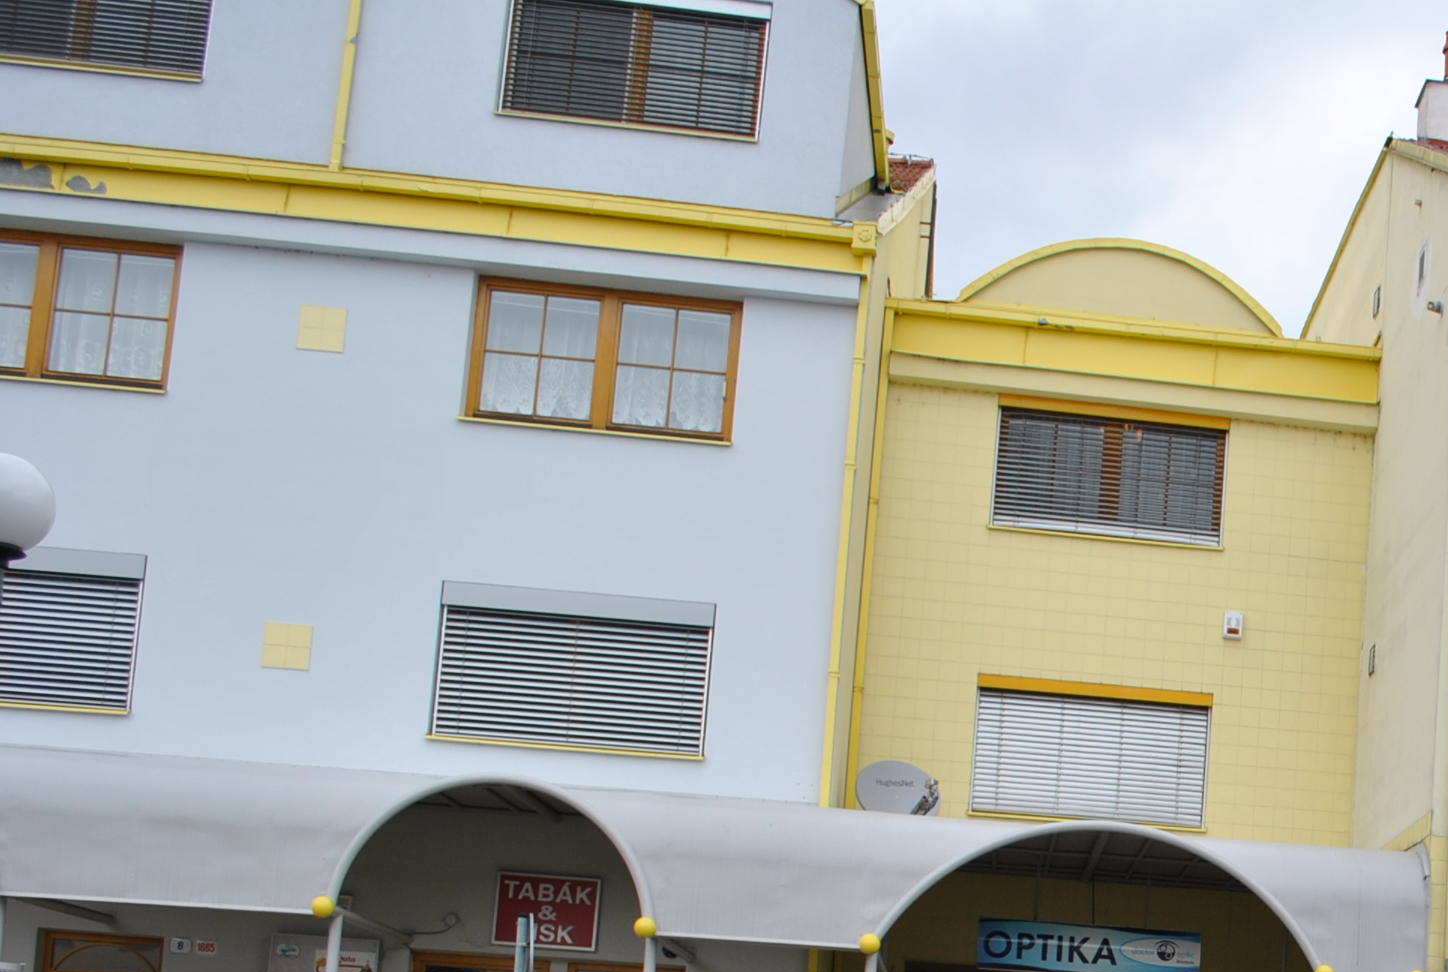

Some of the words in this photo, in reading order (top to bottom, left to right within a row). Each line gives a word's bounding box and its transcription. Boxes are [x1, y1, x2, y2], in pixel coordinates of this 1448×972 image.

[503, 880, 592, 905] TABÁK
[537, 905, 557, 921] &
[983, 930, 1117, 966] OPTIKA
